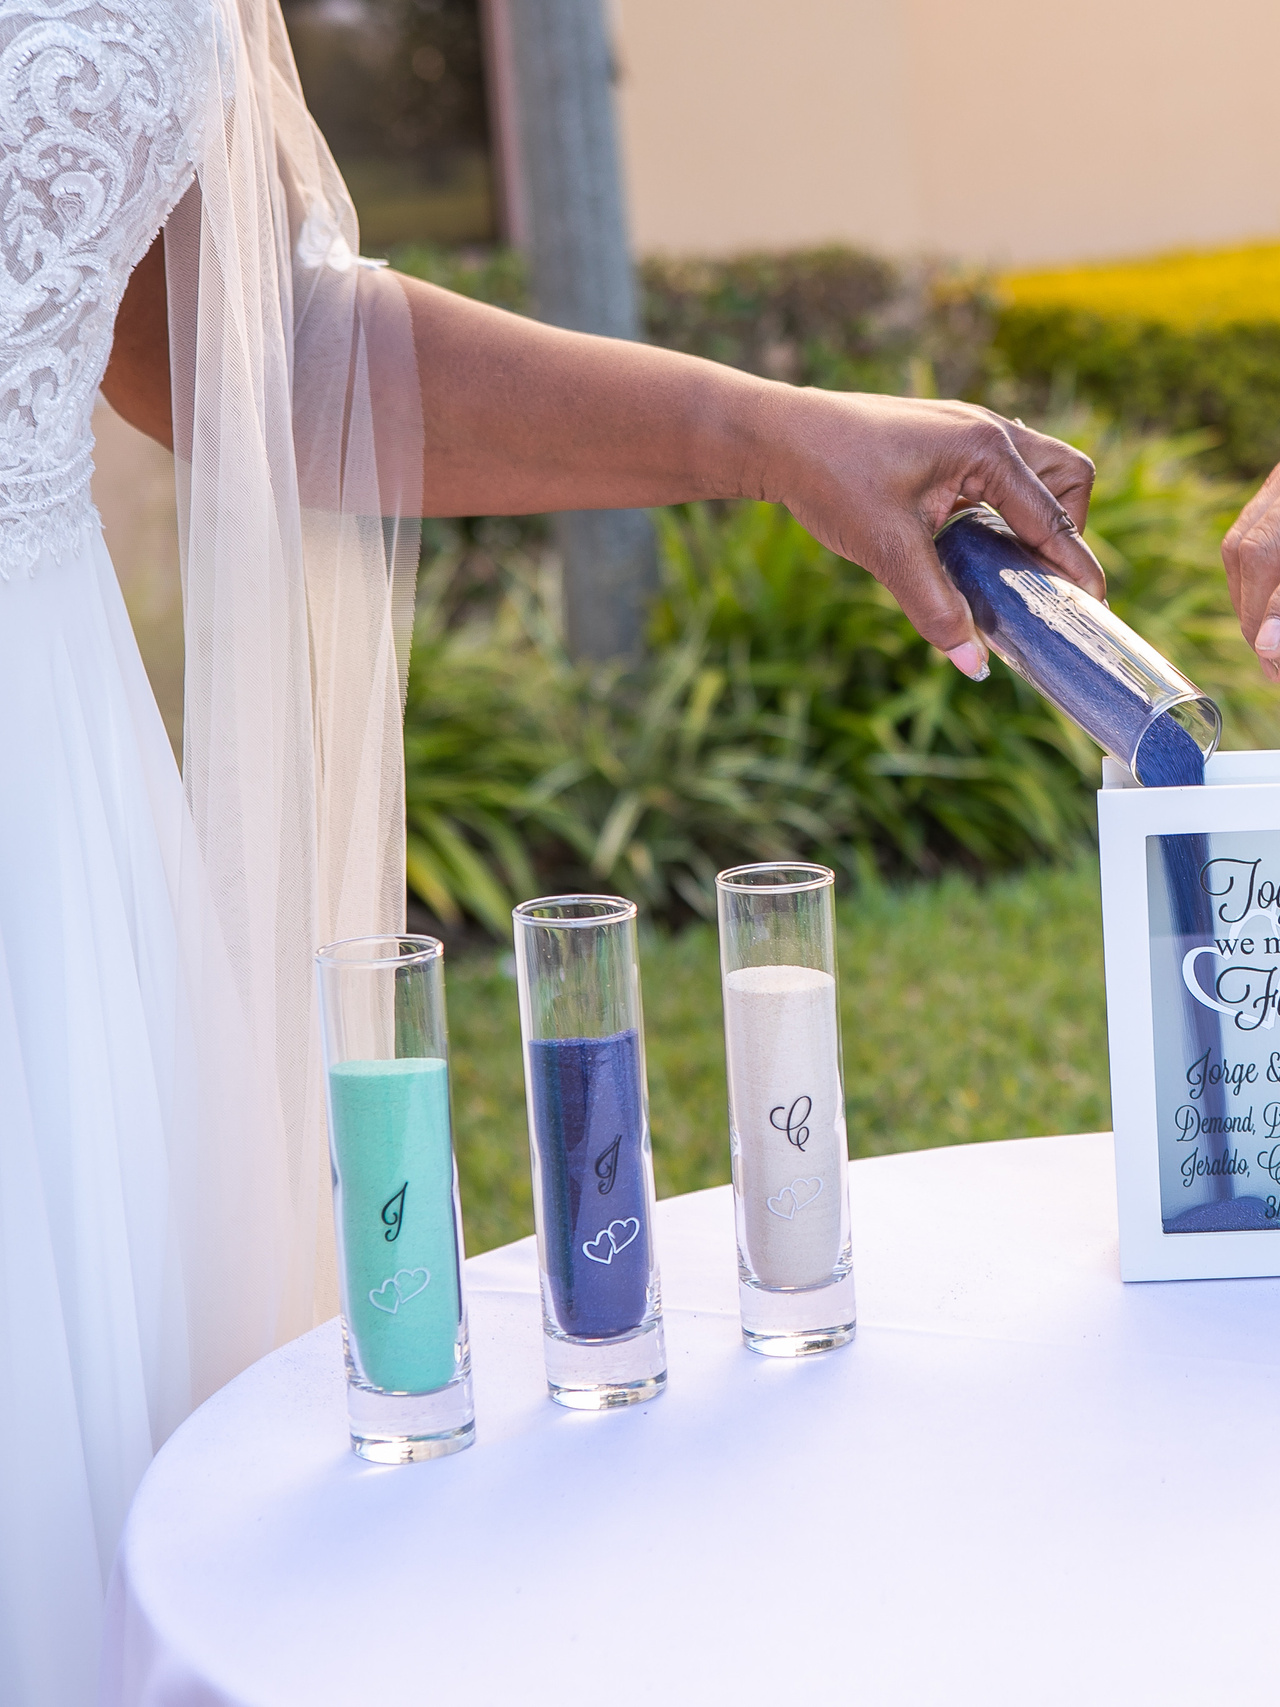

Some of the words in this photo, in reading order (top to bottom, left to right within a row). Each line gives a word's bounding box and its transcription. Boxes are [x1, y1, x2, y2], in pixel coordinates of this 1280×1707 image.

[1214, 935, 1255, 956] we
[1185, 1046, 1259, 1100] Jorge
[769, 1095, 813, 1153] C
[1174, 1103, 1257, 1142] Demond,
[1180, 1146, 1251, 1188] Jeraldo,
